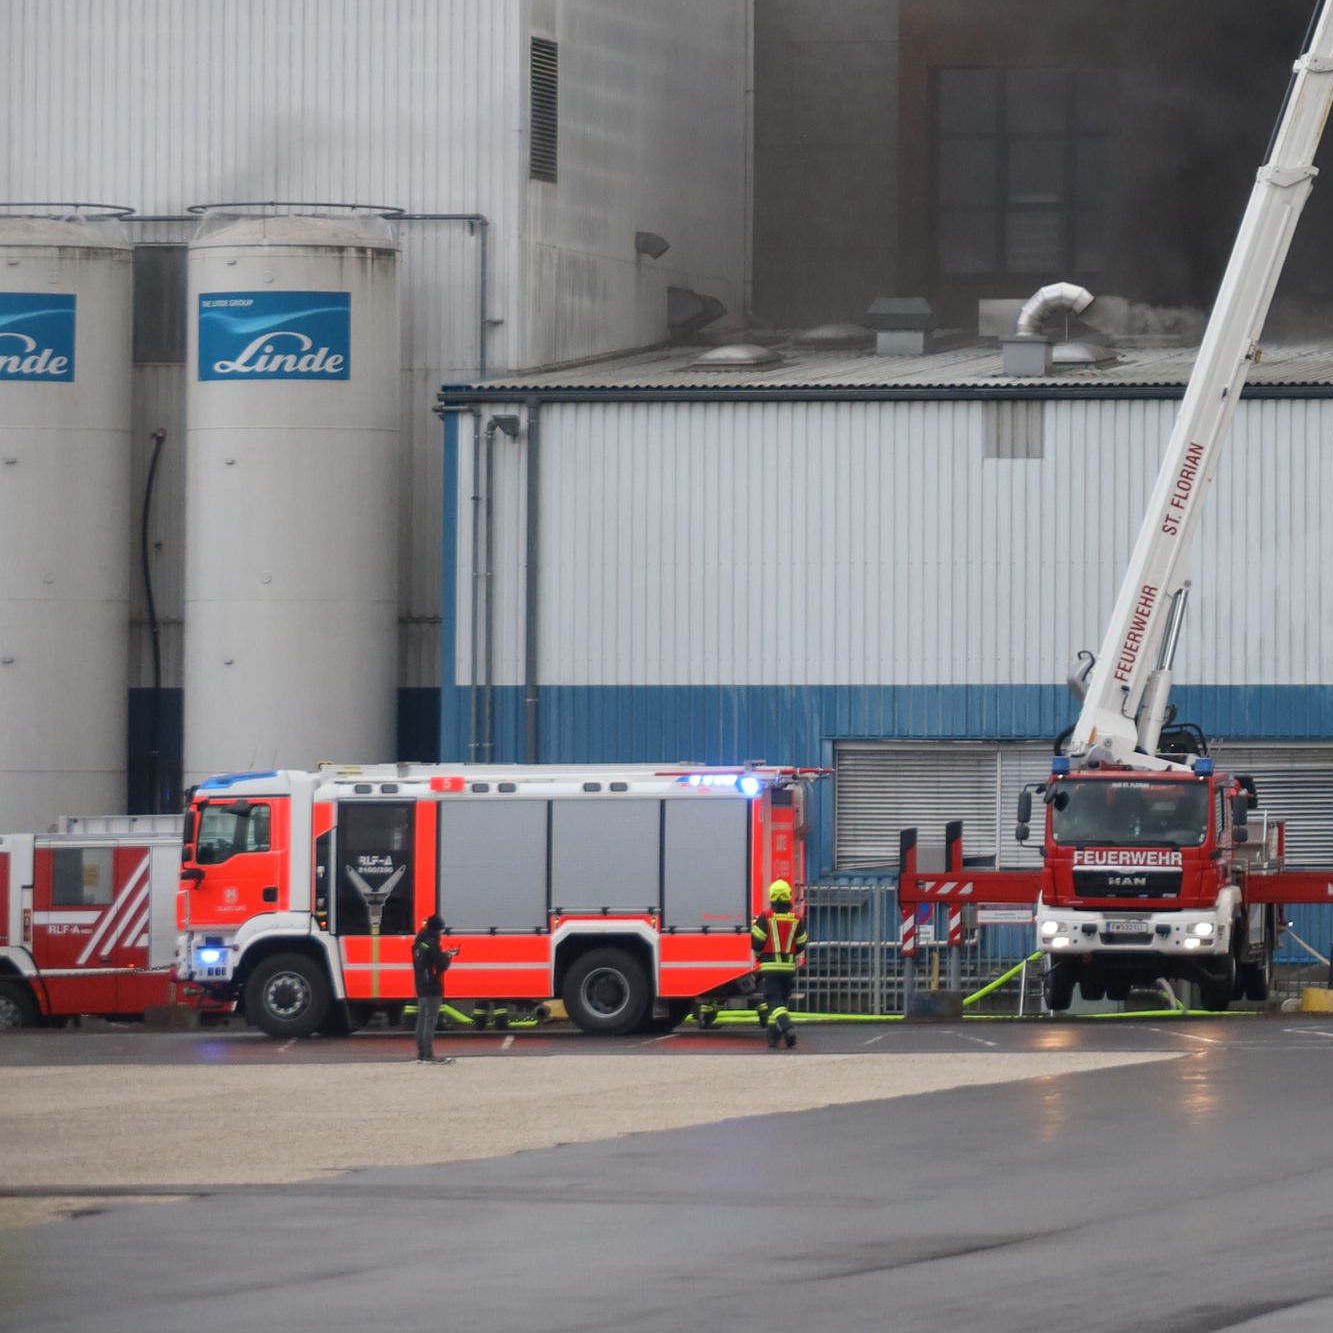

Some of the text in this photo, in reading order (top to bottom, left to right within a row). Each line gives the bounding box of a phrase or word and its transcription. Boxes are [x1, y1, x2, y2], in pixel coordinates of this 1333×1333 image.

[229, 299, 254, 307] GROUP
[214, 331, 345, 374] Linde
[1114, 442, 1205, 682] FEUERWEHR ST. FLORIAN
[443, 778, 451, 788] 5
[1073, 850, 1183, 866] FEUERWEHR
[1108, 877, 1146, 886] MAN
